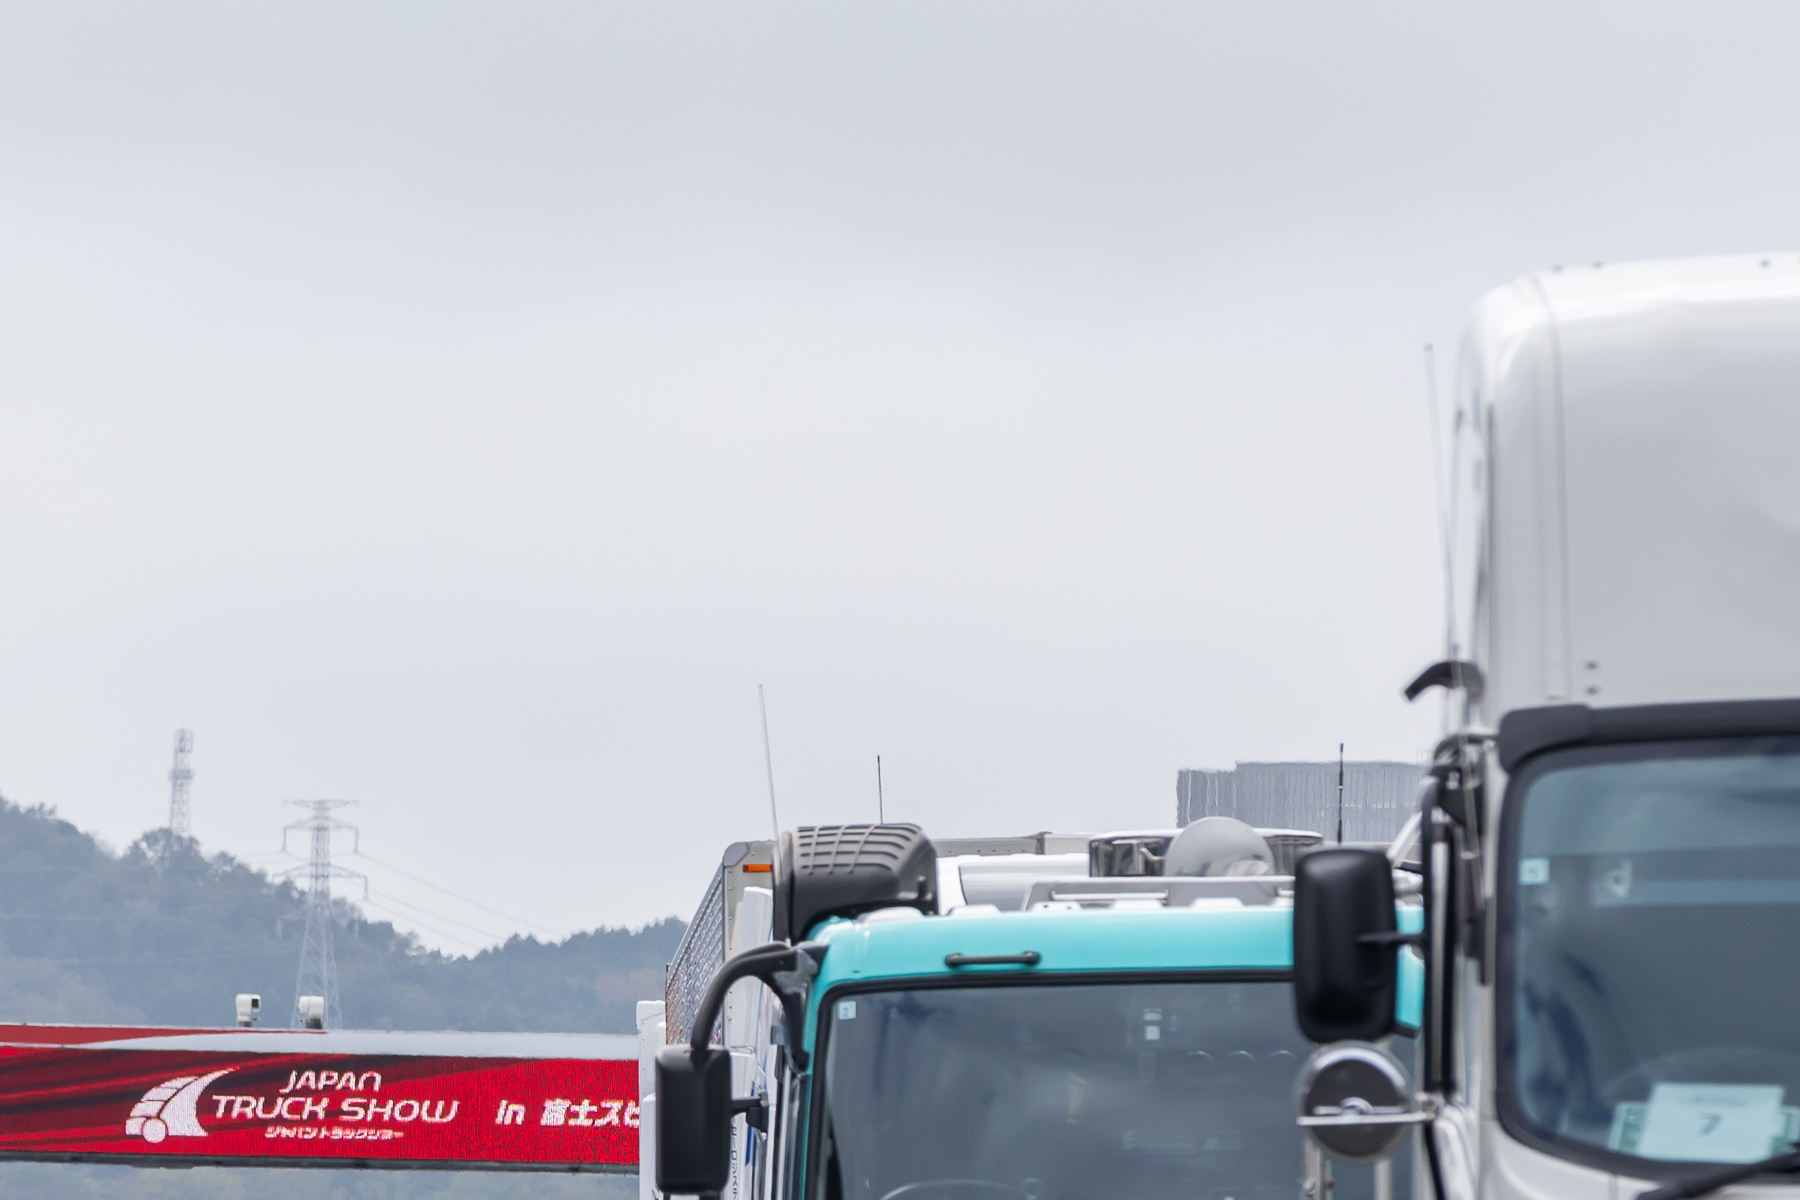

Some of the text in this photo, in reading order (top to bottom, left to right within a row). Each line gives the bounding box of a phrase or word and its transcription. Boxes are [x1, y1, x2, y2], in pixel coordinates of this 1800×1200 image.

[279, 1070, 381, 1094] JAPAN
[212, 1094, 460, 1124] TRUCK SHOW
